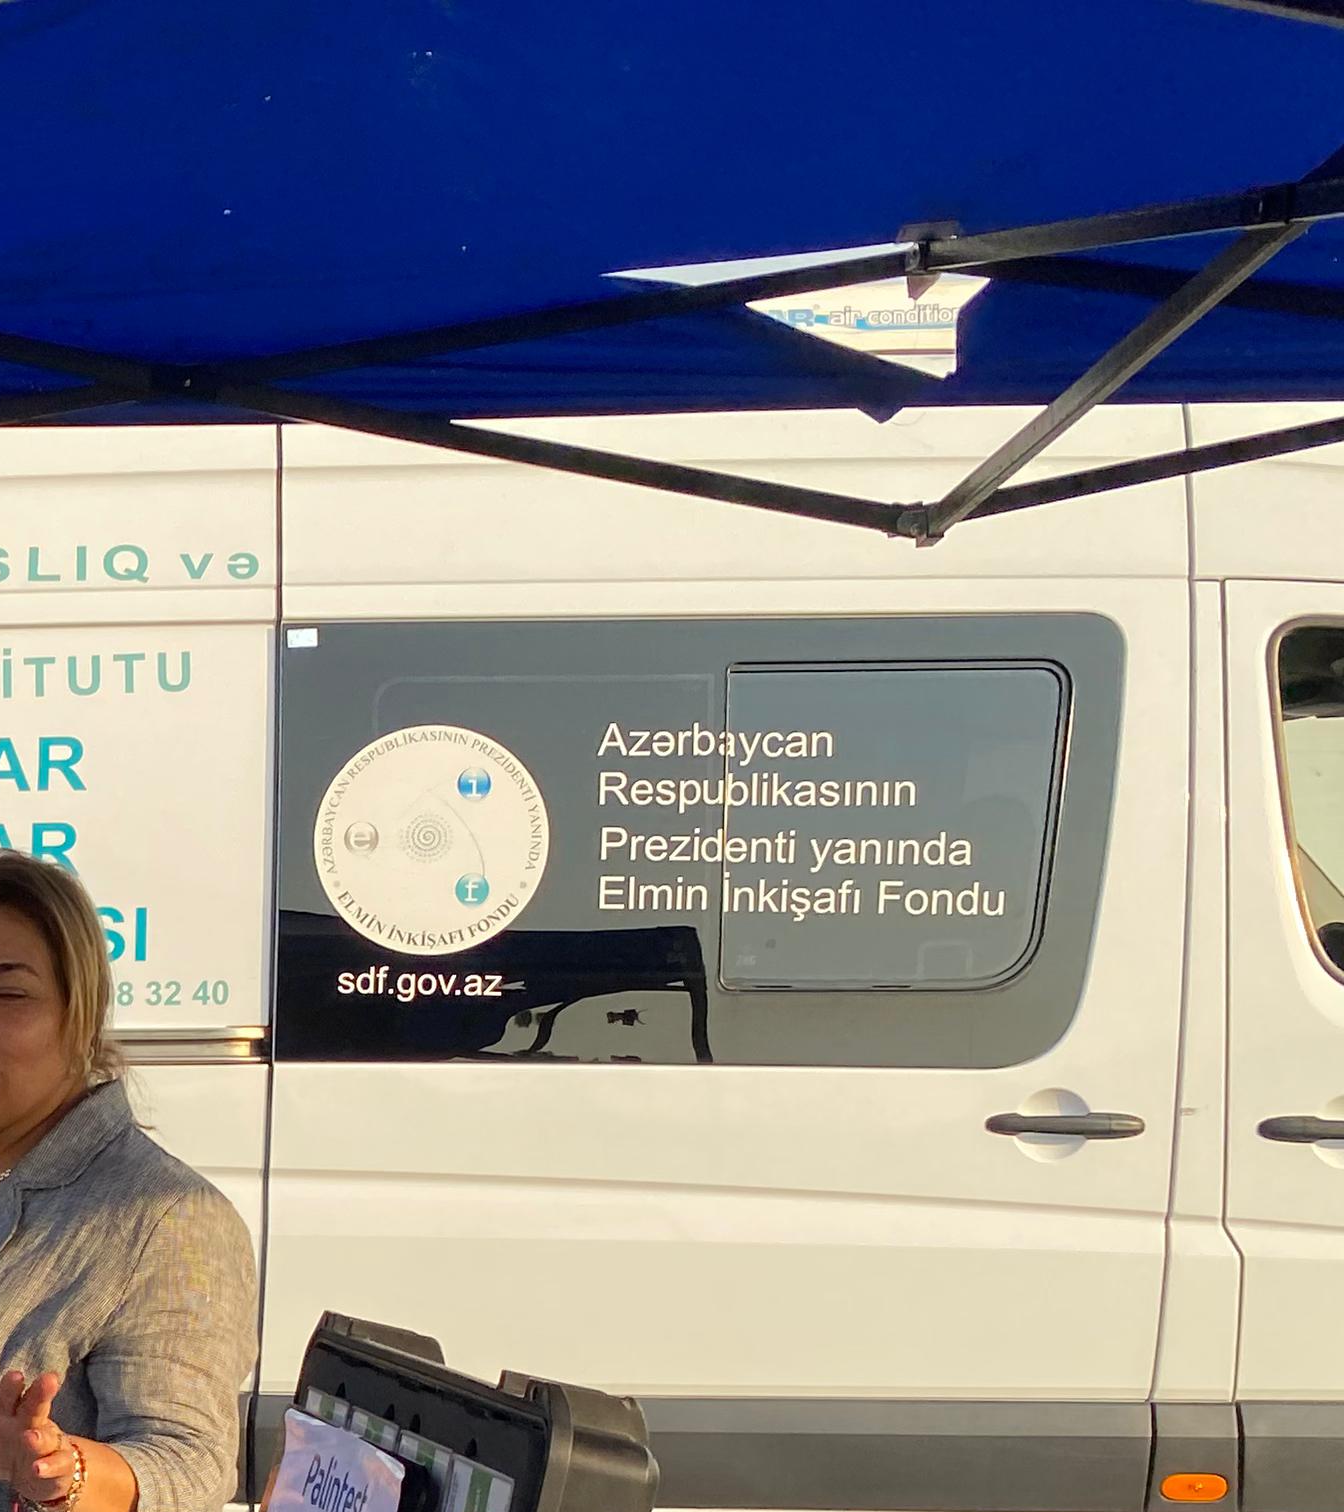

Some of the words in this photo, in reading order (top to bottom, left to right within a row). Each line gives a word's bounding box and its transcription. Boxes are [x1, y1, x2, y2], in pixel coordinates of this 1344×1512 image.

[180, 552, 259, 580] və
[597, 722, 833, 766] Azərbaycan
[598, 771, 916, 813] Respublikasının
[599, 827, 797, 864] Prezidenti
[810, 832, 972, 872] yanında
[337, 890, 387, 935] ELMİN
[468, 893, 519, 939] FONDU
[598, 876, 708, 912] Elmin
[723, 872, 860, 921] İnkişafı
[878, 881, 1006, 916] Fondu
[145, 981, 181, 1006] 32
[192, 980, 229, 1005] 40
[337, 966, 502, 1002] sdf.gov.az
